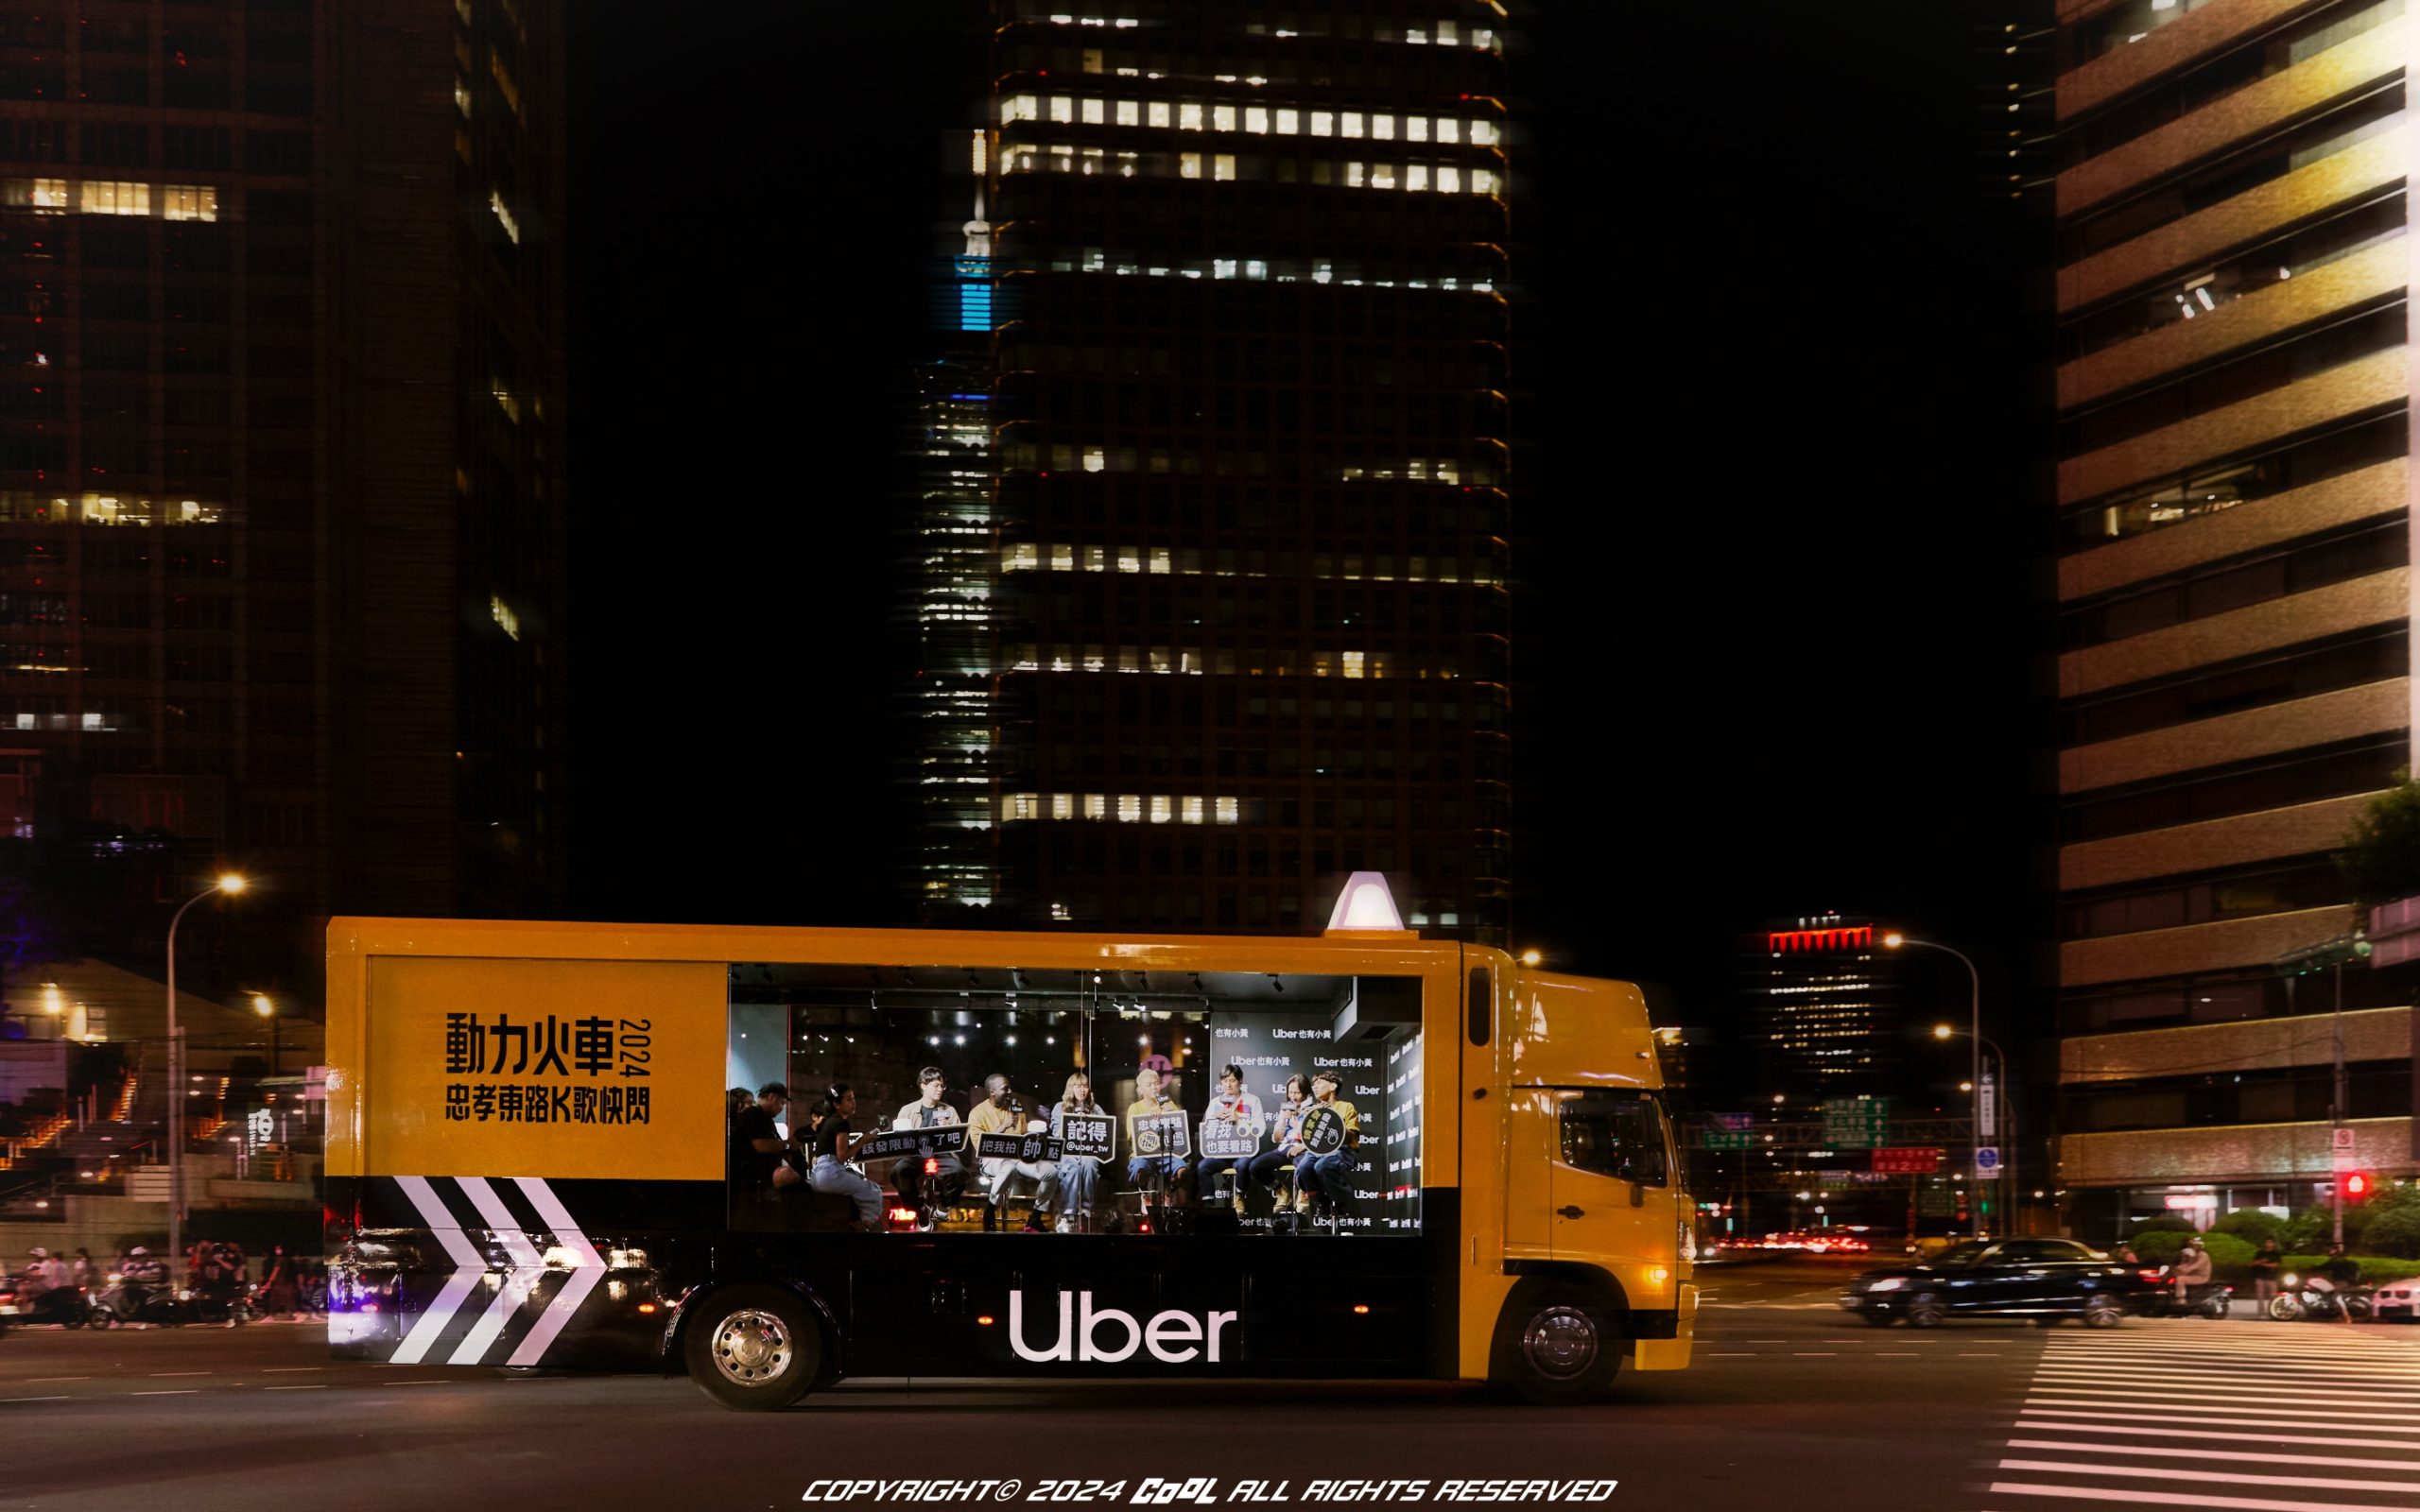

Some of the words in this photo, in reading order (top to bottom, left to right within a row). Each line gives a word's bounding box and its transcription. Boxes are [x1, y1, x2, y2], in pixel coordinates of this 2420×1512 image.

[1215, 1028, 1249, 1038] 也有小黃
[1272, 1028, 1297, 1039] Uber
[1299, 1029, 1331, 1040] 也有小黃
[446, 1012, 614, 1077] 動力火車
[619, 1019, 651, 1077] 2024
[1231, 1056, 1255, 1066] Uber
[1256, 1057, 1290, 1066] 也有小黃
[1314, 1057, 1339, 1067] Uber
[1340, 1057, 1373, 1068] 也有小黃
[1355, 1086, 1380, 1095] Uber
[445, 1083, 650, 1125] 忠孝東路K歌快閃
[1067, 1120, 1108, 1143] 記得
[1204, 1119, 1233, 1140] 看我
[861, 1137, 916, 1156] 該發限動
[934, 1132, 961, 1146] 了吧
[981, 1139, 1017, 1154] 把我拍
[1022, 1137, 1043, 1159] 帥
[1066, 1142, 1110, 1154] @uber_tw
[1206, 1140, 1253, 1153] 也要看路
[1354, 1190, 1379, 1199] Uber
[1312, 1217, 1333, 1227] Ube
[1339, 1217, 1372, 1227] 也有小黃
[1009, 1290, 1237, 1363] Uber
